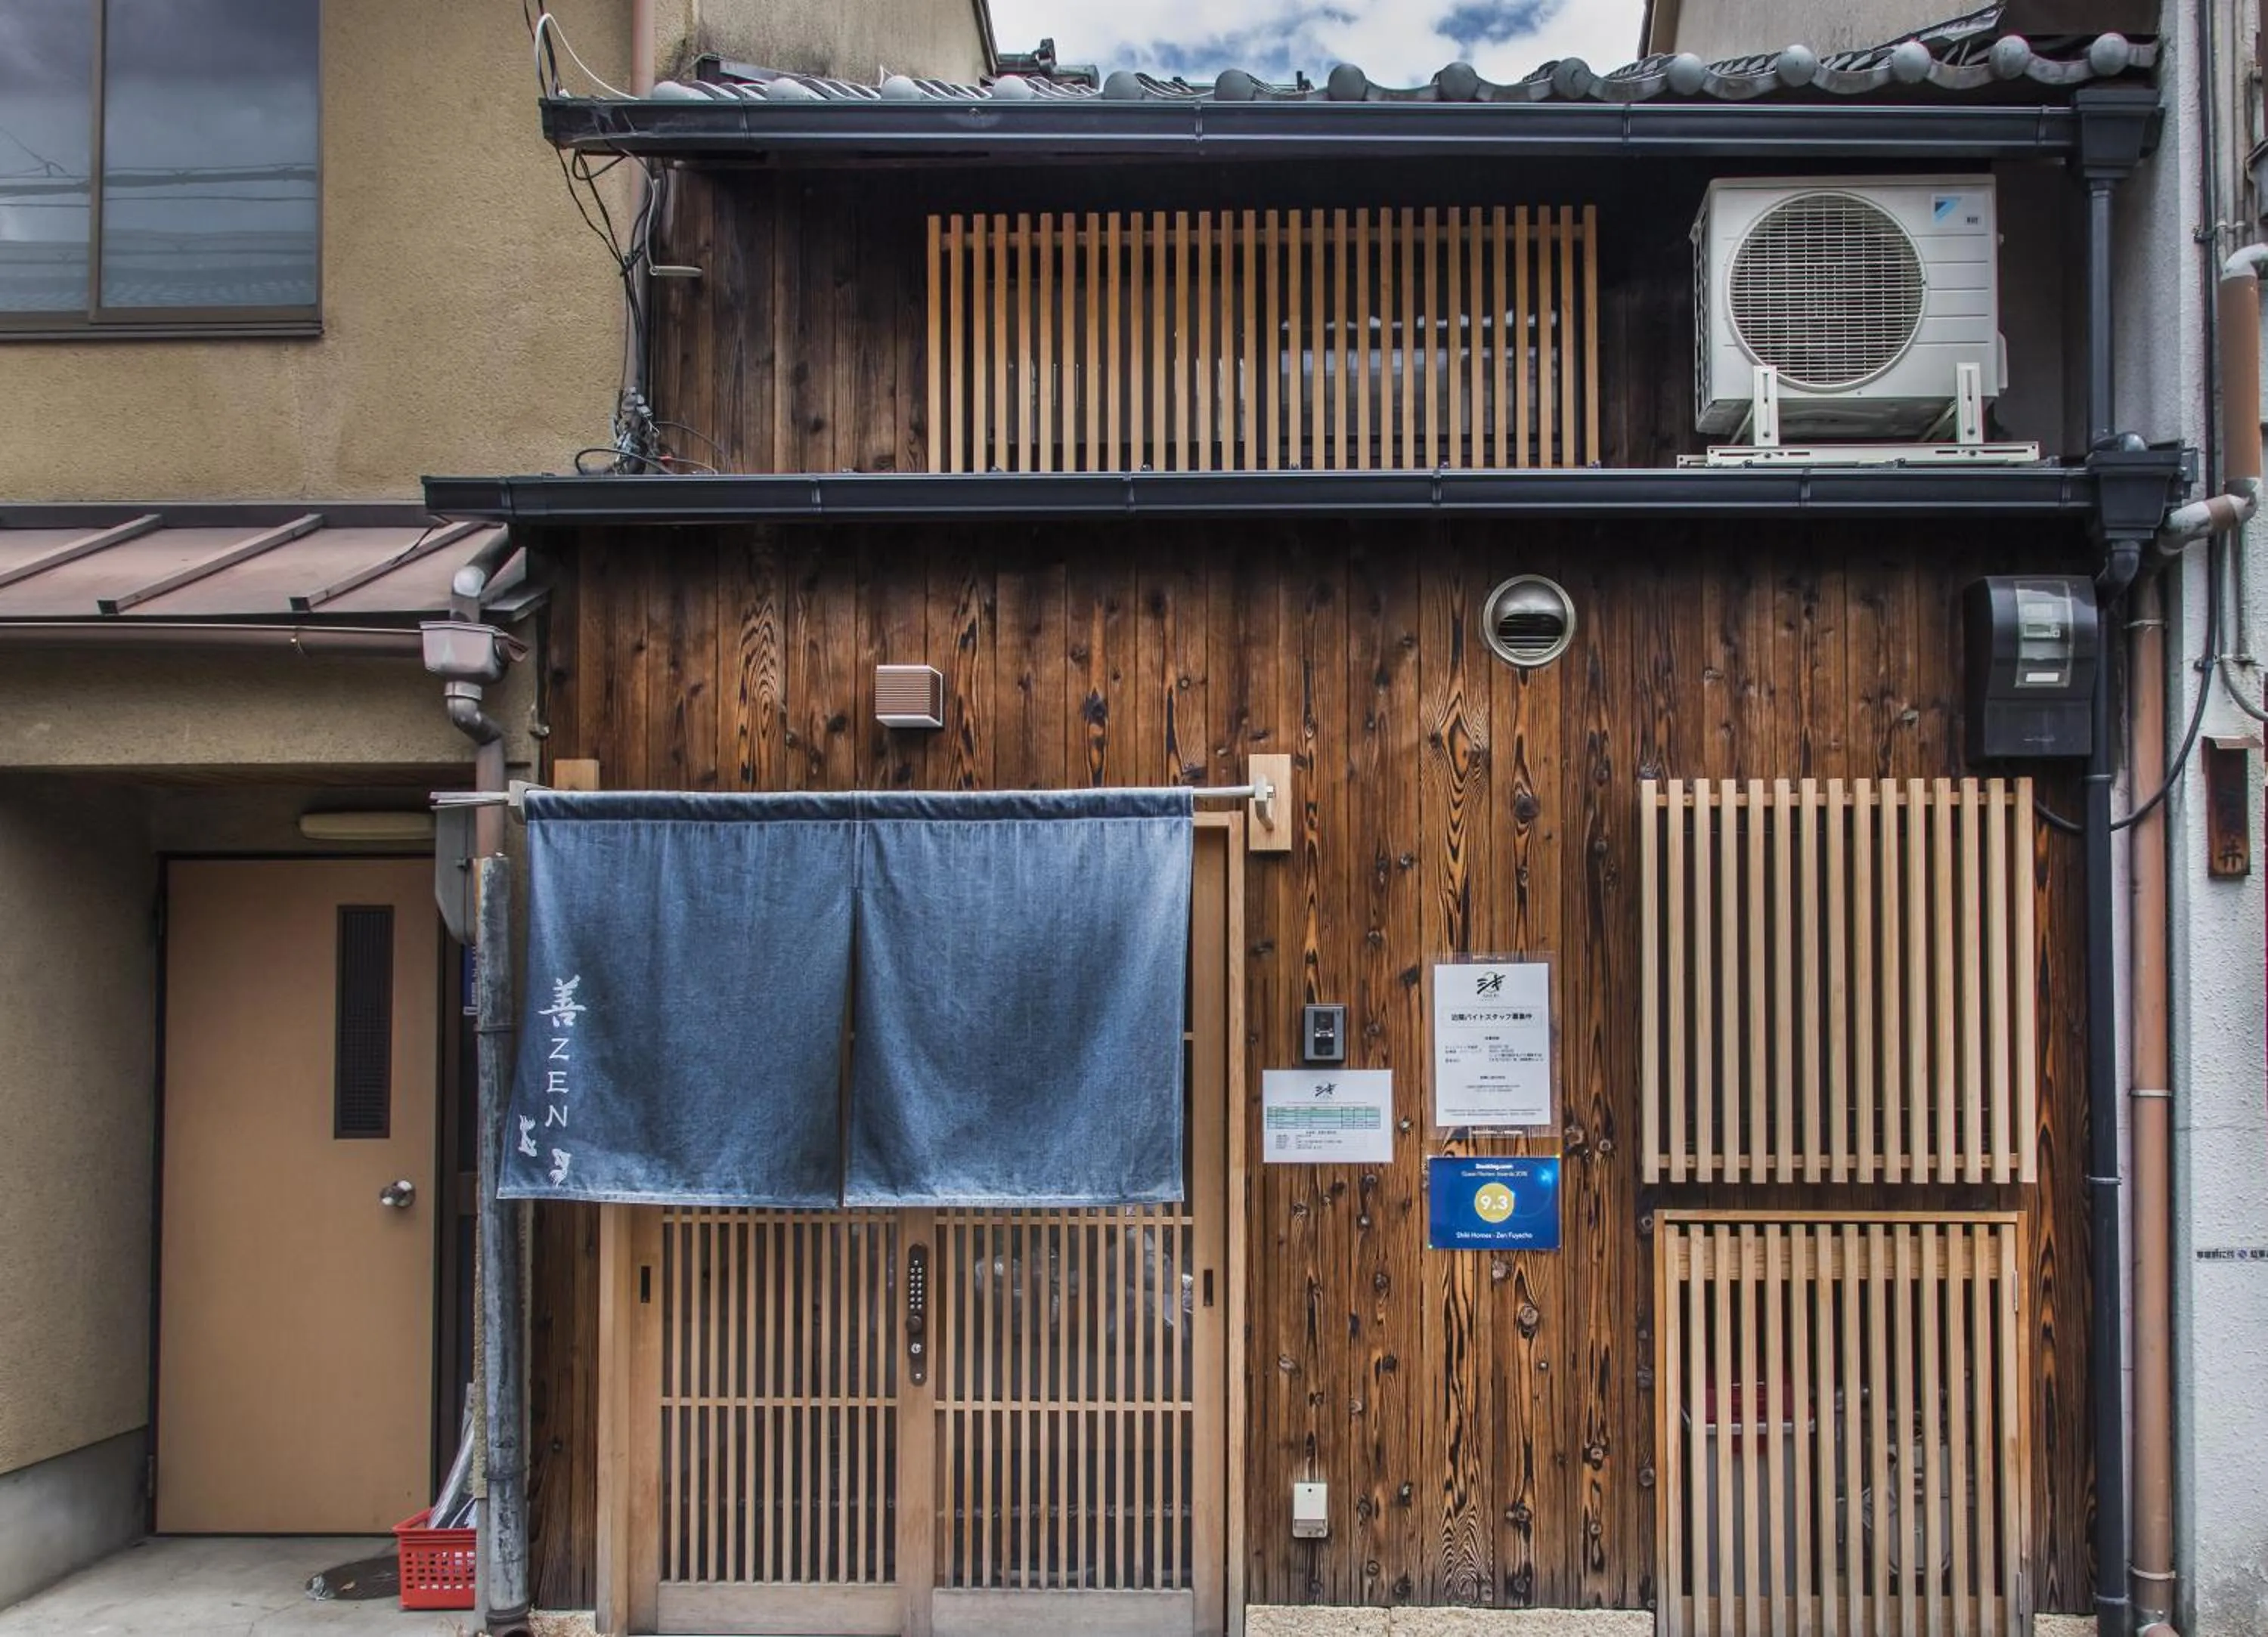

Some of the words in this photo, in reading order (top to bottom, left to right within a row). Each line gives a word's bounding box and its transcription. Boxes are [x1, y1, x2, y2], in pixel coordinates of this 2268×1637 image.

[538, 975, 587, 1028] 善
[545, 1038, 569, 1128] ZEN
[1480, 1195, 1508, 1210] 9.3
